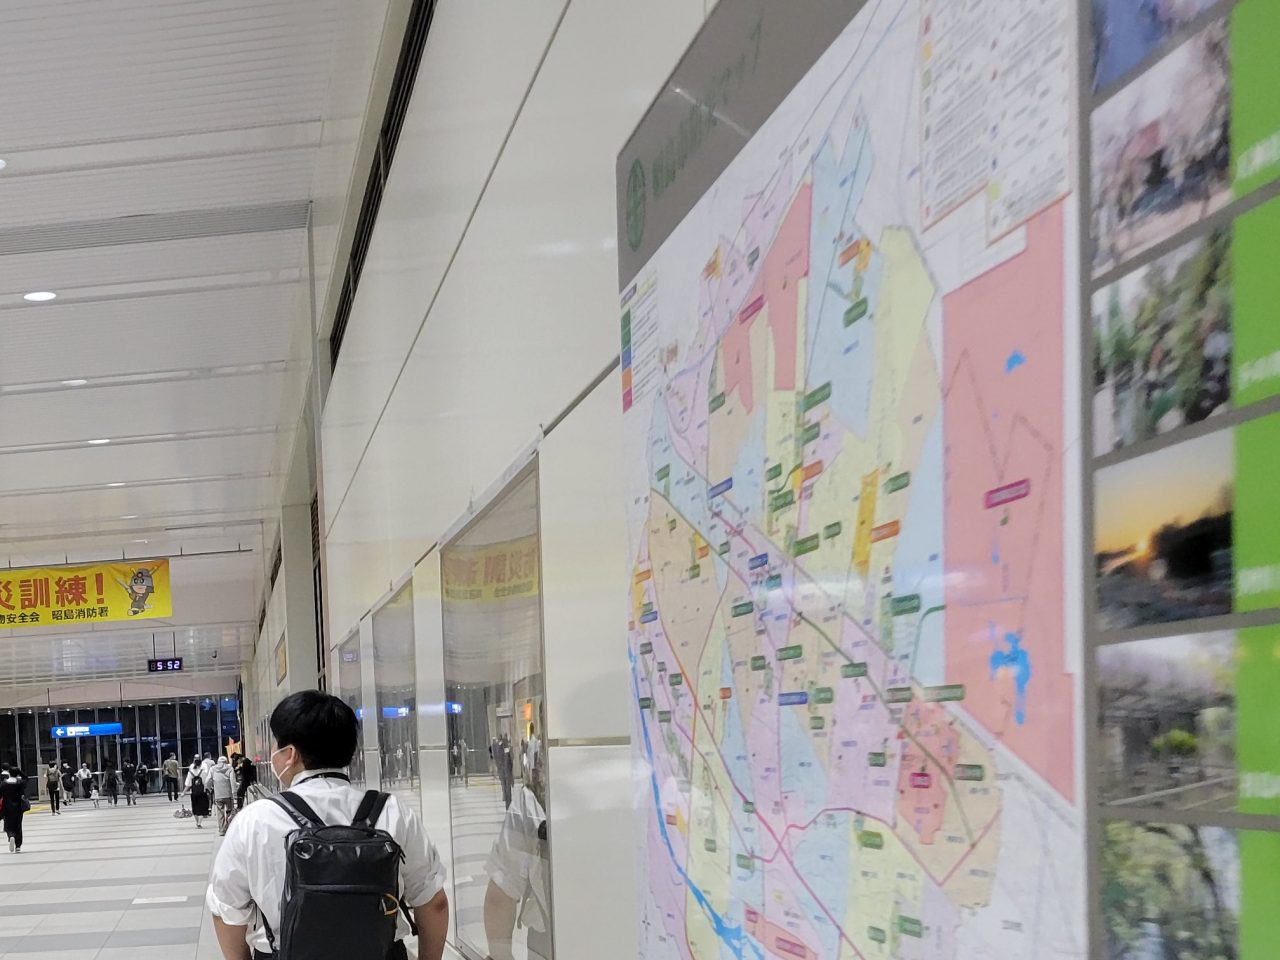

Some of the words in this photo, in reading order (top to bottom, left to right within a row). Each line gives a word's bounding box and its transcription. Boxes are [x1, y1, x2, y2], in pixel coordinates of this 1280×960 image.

[51, 606, 109, 621] 昭島消防署
